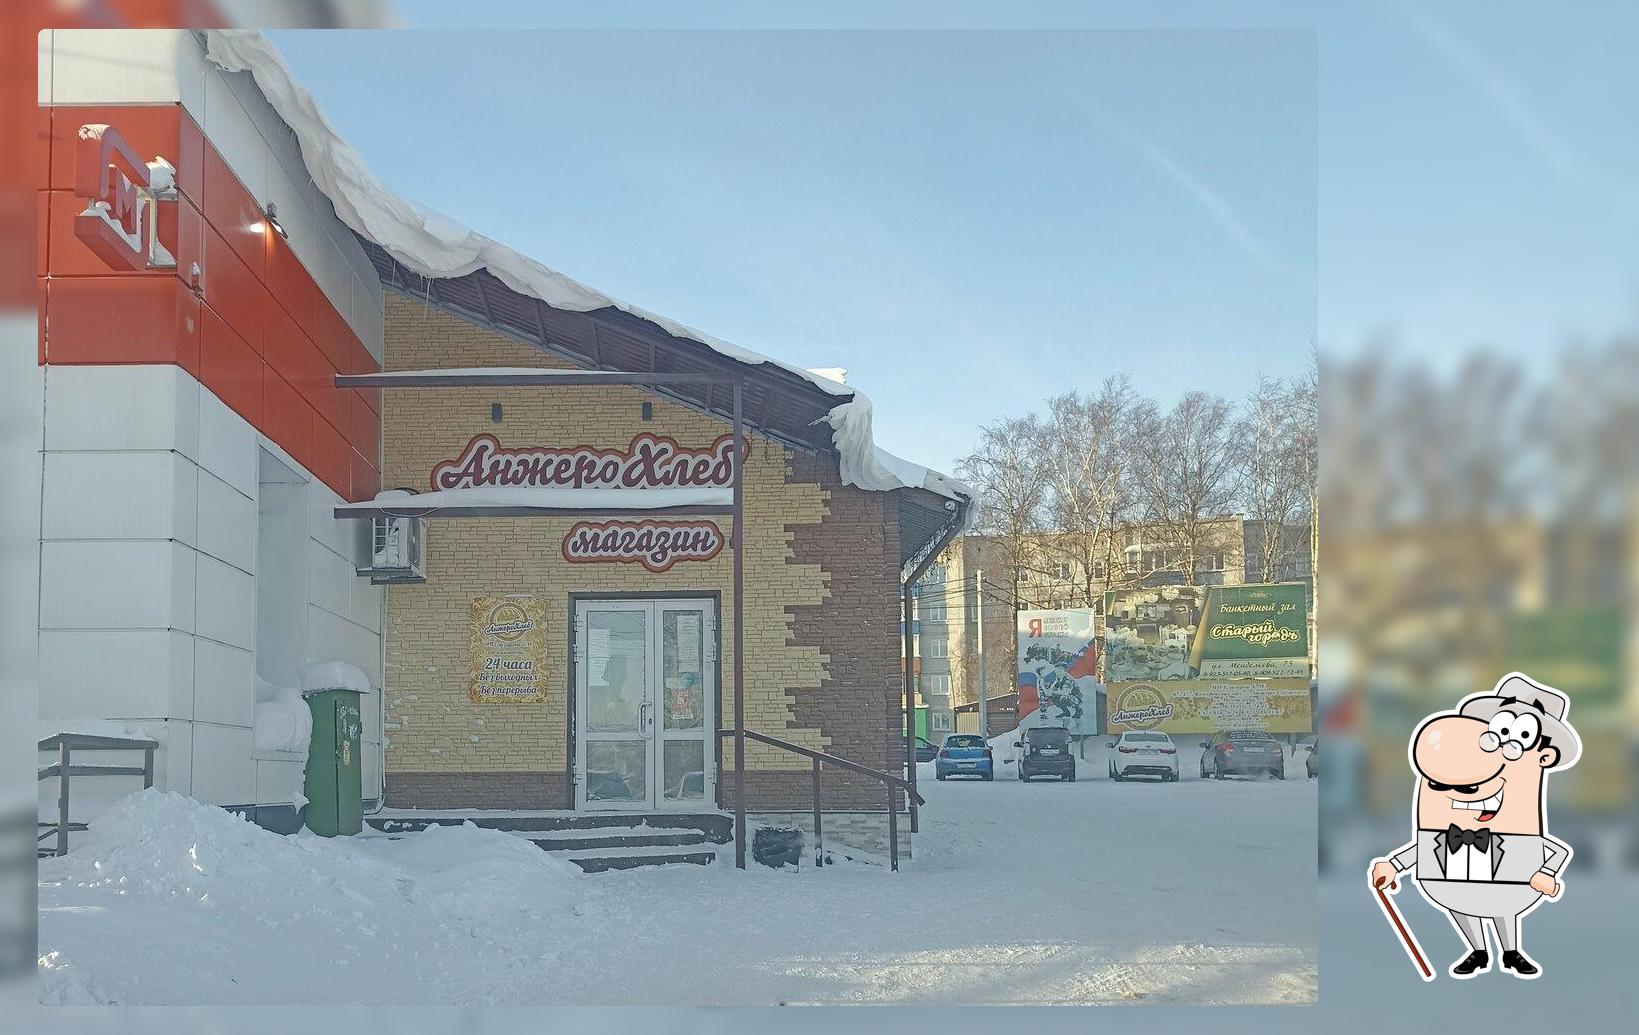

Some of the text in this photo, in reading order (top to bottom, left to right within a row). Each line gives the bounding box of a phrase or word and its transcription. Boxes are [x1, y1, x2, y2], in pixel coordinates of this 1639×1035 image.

[571, 526, 716, 563] магазин
[1219, 602, 1297, 614] Банкетный зал
[1029, 618, 1042, 638] Я
[1211, 619, 1275, 639] Старый
[485, 657, 532, 669] 24 часа
[479, 672, 538, 682] Без выходных
[481, 685, 537, 695] Без перерыва
